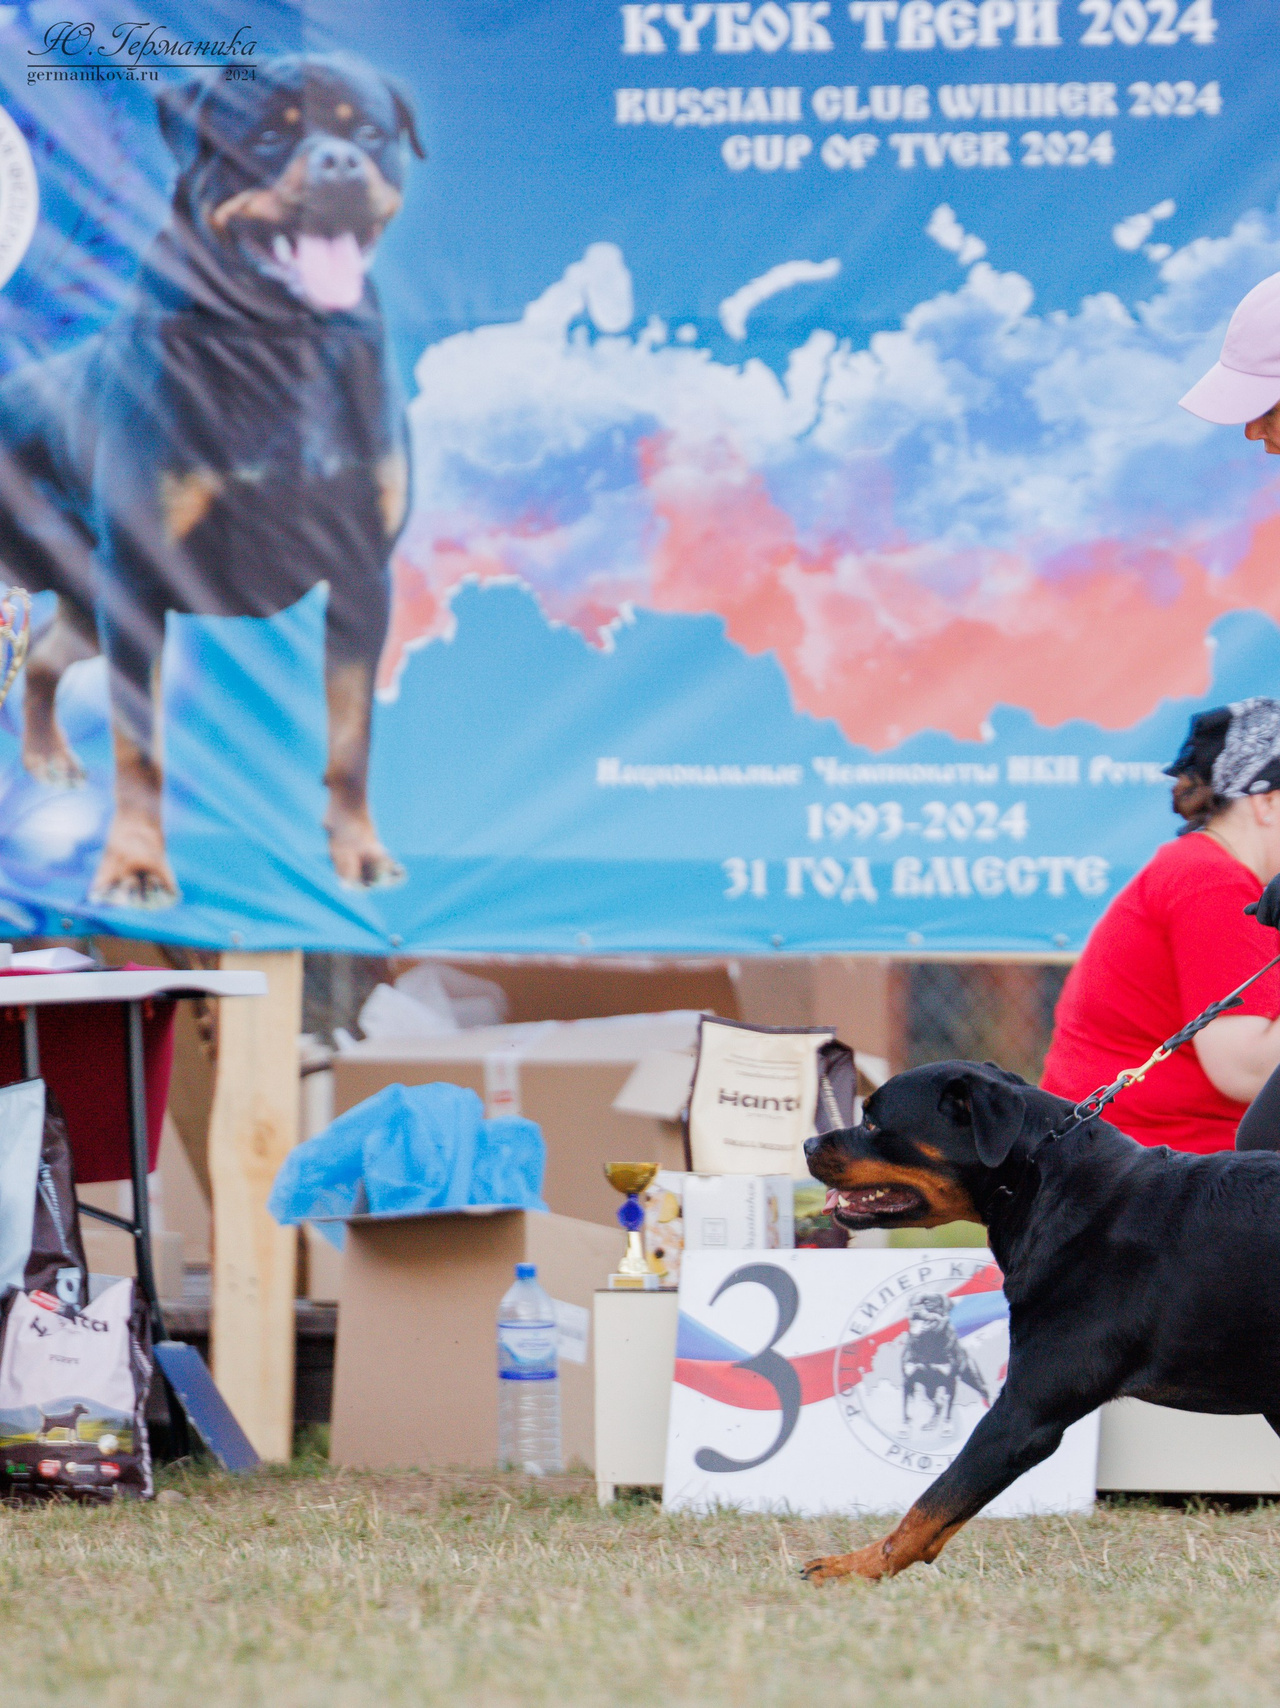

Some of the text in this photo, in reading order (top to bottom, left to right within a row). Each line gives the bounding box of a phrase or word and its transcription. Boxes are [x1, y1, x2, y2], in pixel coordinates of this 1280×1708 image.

[621, 0, 1219, 52] КУБОК ТВЕРИ 2024
[615, 80, 1223, 126] RUSSIAN CLUB WINNER 2024
[721, 129, 1116, 171] CUP OF TVER 2024
[807, 801, 1028, 843] 1993-2024
[722, 855, 1109, 904] 31 ГОД ВМЕСТЕ
[694, 1262, 800, 1473] 3
